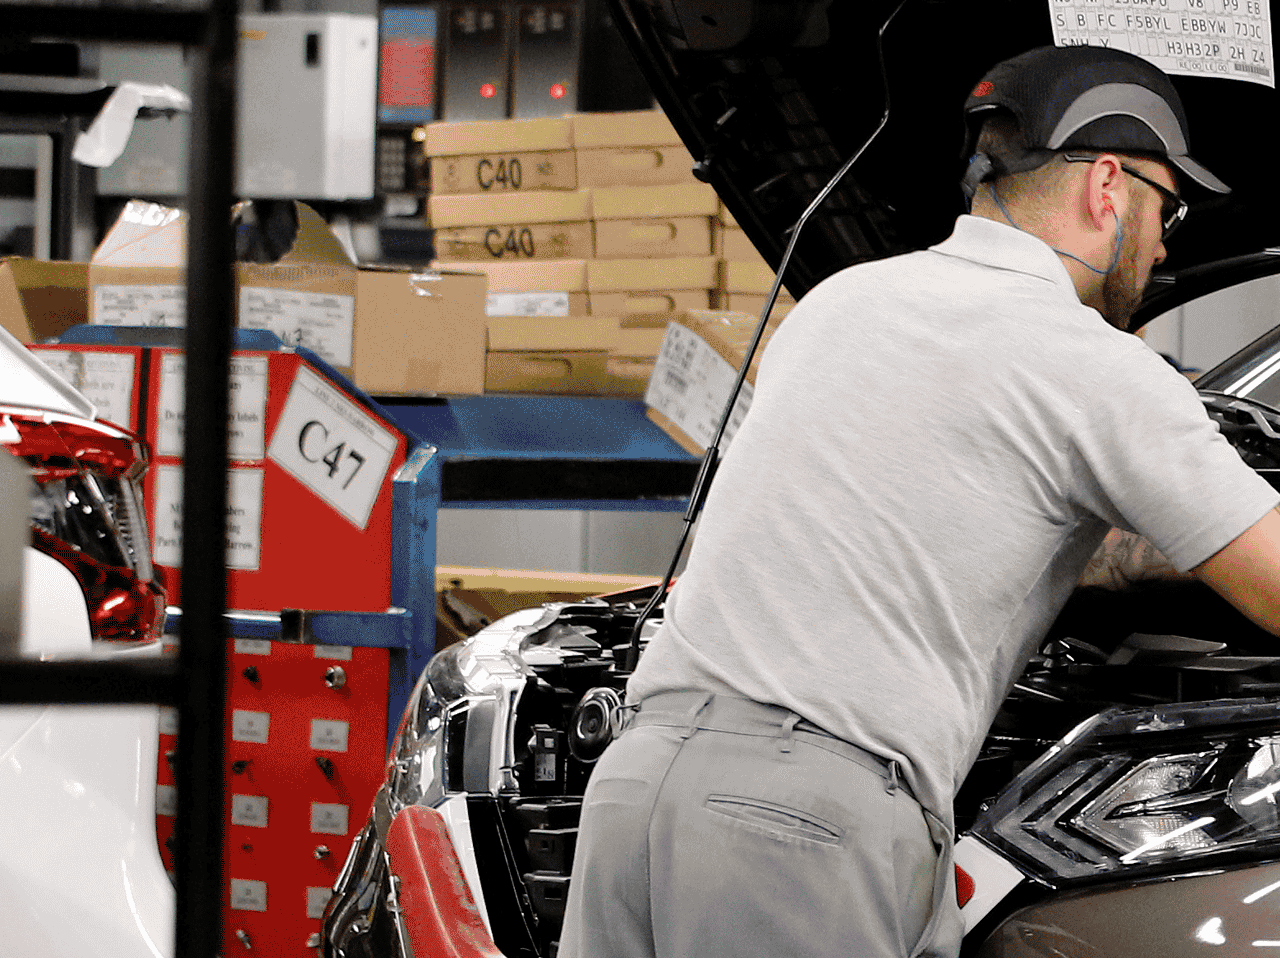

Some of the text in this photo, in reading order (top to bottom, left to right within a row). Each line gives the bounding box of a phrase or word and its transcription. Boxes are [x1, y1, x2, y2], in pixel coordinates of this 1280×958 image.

[1077, 14, 1086, 27] B
[477, 157, 523, 191] C40
[484, 227, 536, 258] C40
[299, 420, 367, 490] C47
